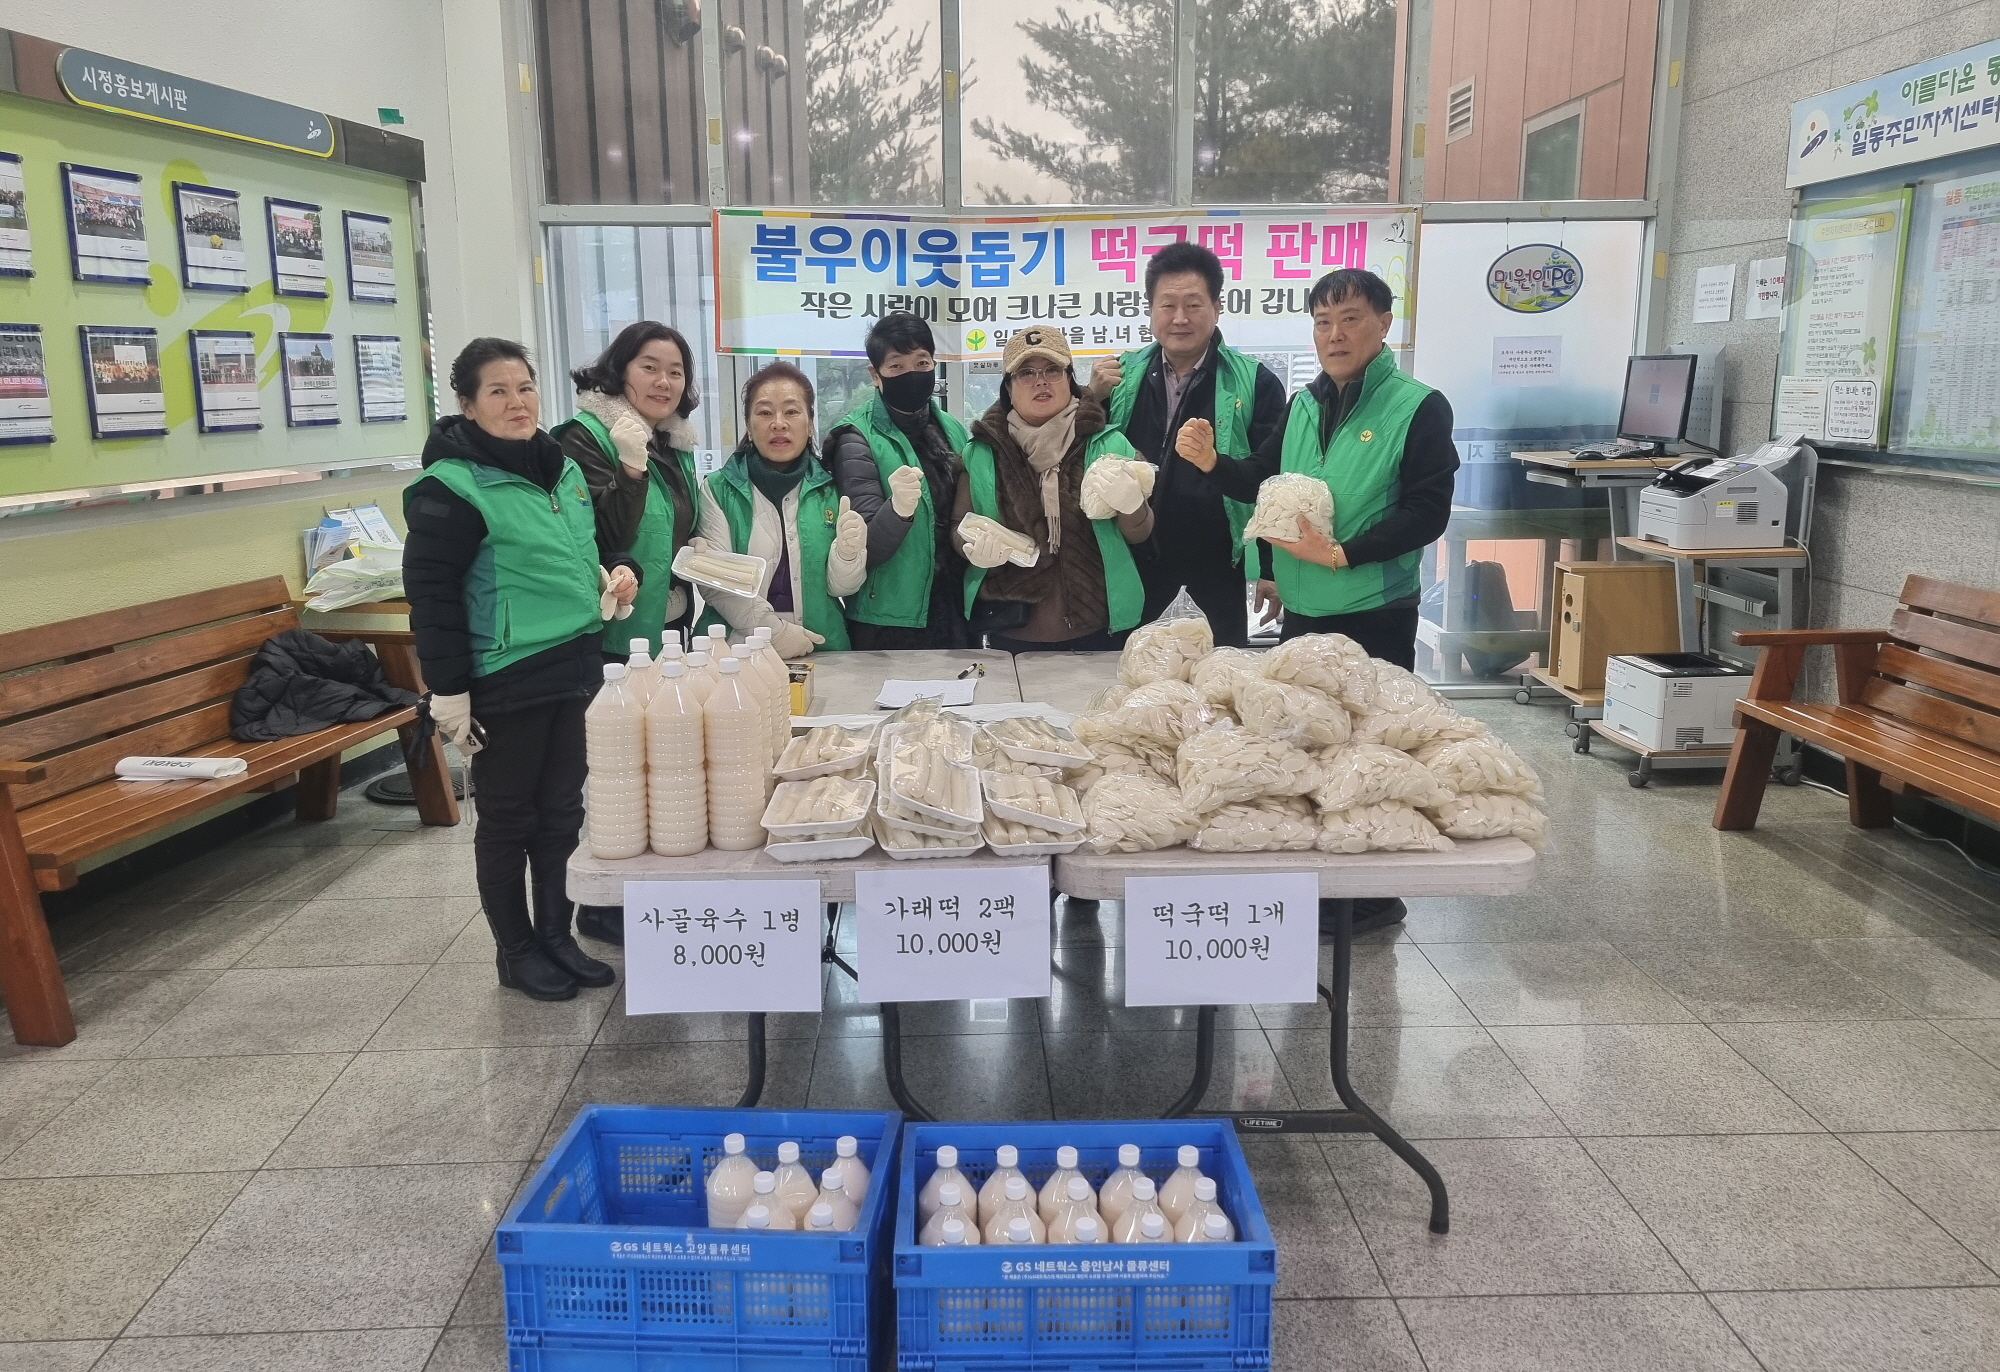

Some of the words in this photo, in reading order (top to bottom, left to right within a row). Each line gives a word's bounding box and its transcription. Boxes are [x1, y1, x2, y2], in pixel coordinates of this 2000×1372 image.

[82, 65, 188, 112] 시정홍보게시판
[1901, 62, 1976, 107] 아름다운
[1851, 94, 2000, 156] 일동주민자치센터
[751, 224, 1065, 288] 불우이웃돕기
[1266, 221, 1368, 279] 판매
[1494, 267, 1577, 291] 민원인PC
[801, 292, 853, 319] 작은
[860, 293, 937, 322] 사랑이
[946, 296, 997, 322] 모여
[1005, 292, 1081, 320] 크나큰
[1092, 325, 1131, 344] 남.녀
[638, 907, 748, 934] 사골육수
[763, 908, 800, 933] 1병
[883, 896, 960, 922] 가래떡
[979, 894, 1015, 921] 2팩
[1152, 902, 1229, 928] 떡국떡
[1247, 900, 1284, 926] 1개
[673, 941, 766, 968] 8,000원
[896, 929, 1001, 956] 10,000원
[1165, 935, 1270, 961] 10,000원
[623, 1242, 639, 1252] GS
[687, 1243, 707, 1255] 고양
[709, 1243, 751, 1256] 물류센터
[1015, 1262, 1032, 1272] GS
[1080, 1260, 1124, 1273] 용인남사
[1126, 1260, 1170, 1272] 물류센터
